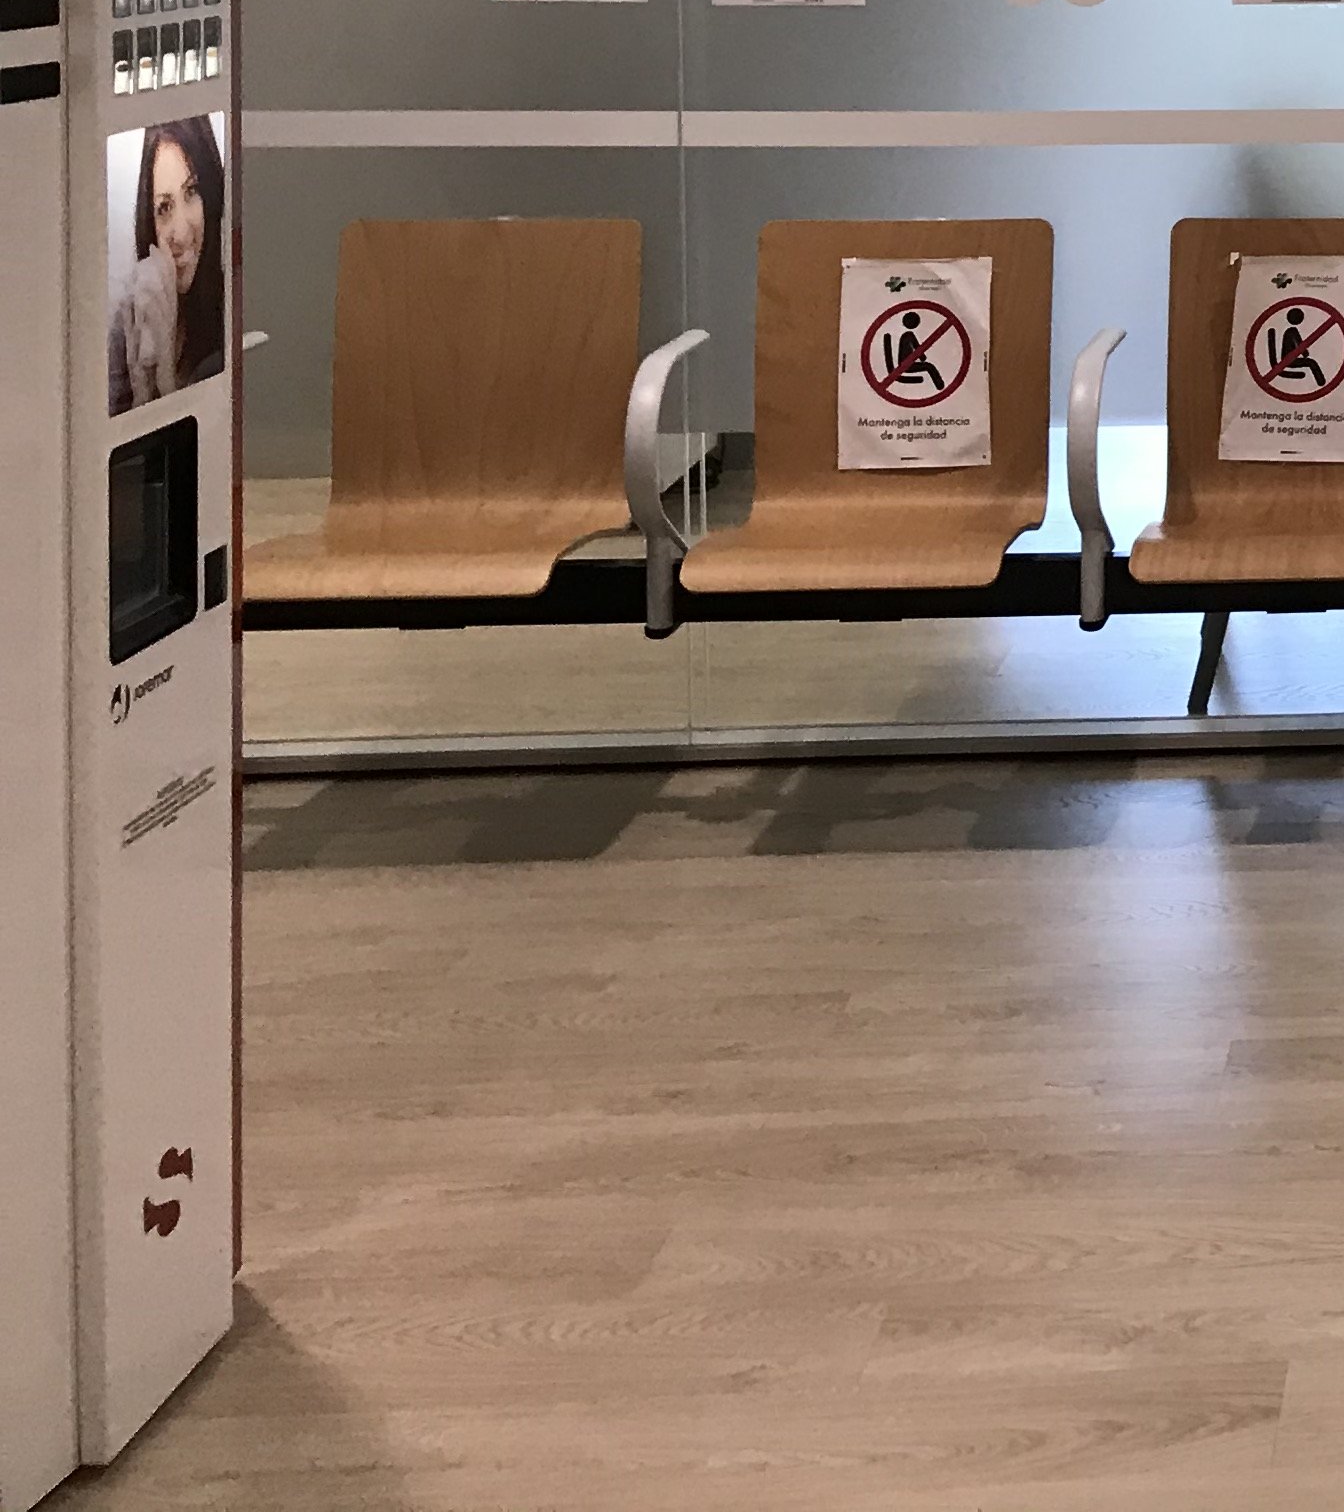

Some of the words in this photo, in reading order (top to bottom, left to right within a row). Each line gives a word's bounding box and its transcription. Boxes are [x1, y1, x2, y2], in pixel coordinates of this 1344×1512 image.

[858, 416, 911, 429] Mantenga
[913, 415, 923, 426] la
[925, 415, 970, 426] distancia
[1240, 409, 1292, 422] Mantenga
[1293, 410, 1304, 421] la
[880, 430, 893, 440] de
[896, 429, 947, 442] seguridad
[1261, 422, 1275, 433] de
[1277, 424, 1327, 436] seguridad
